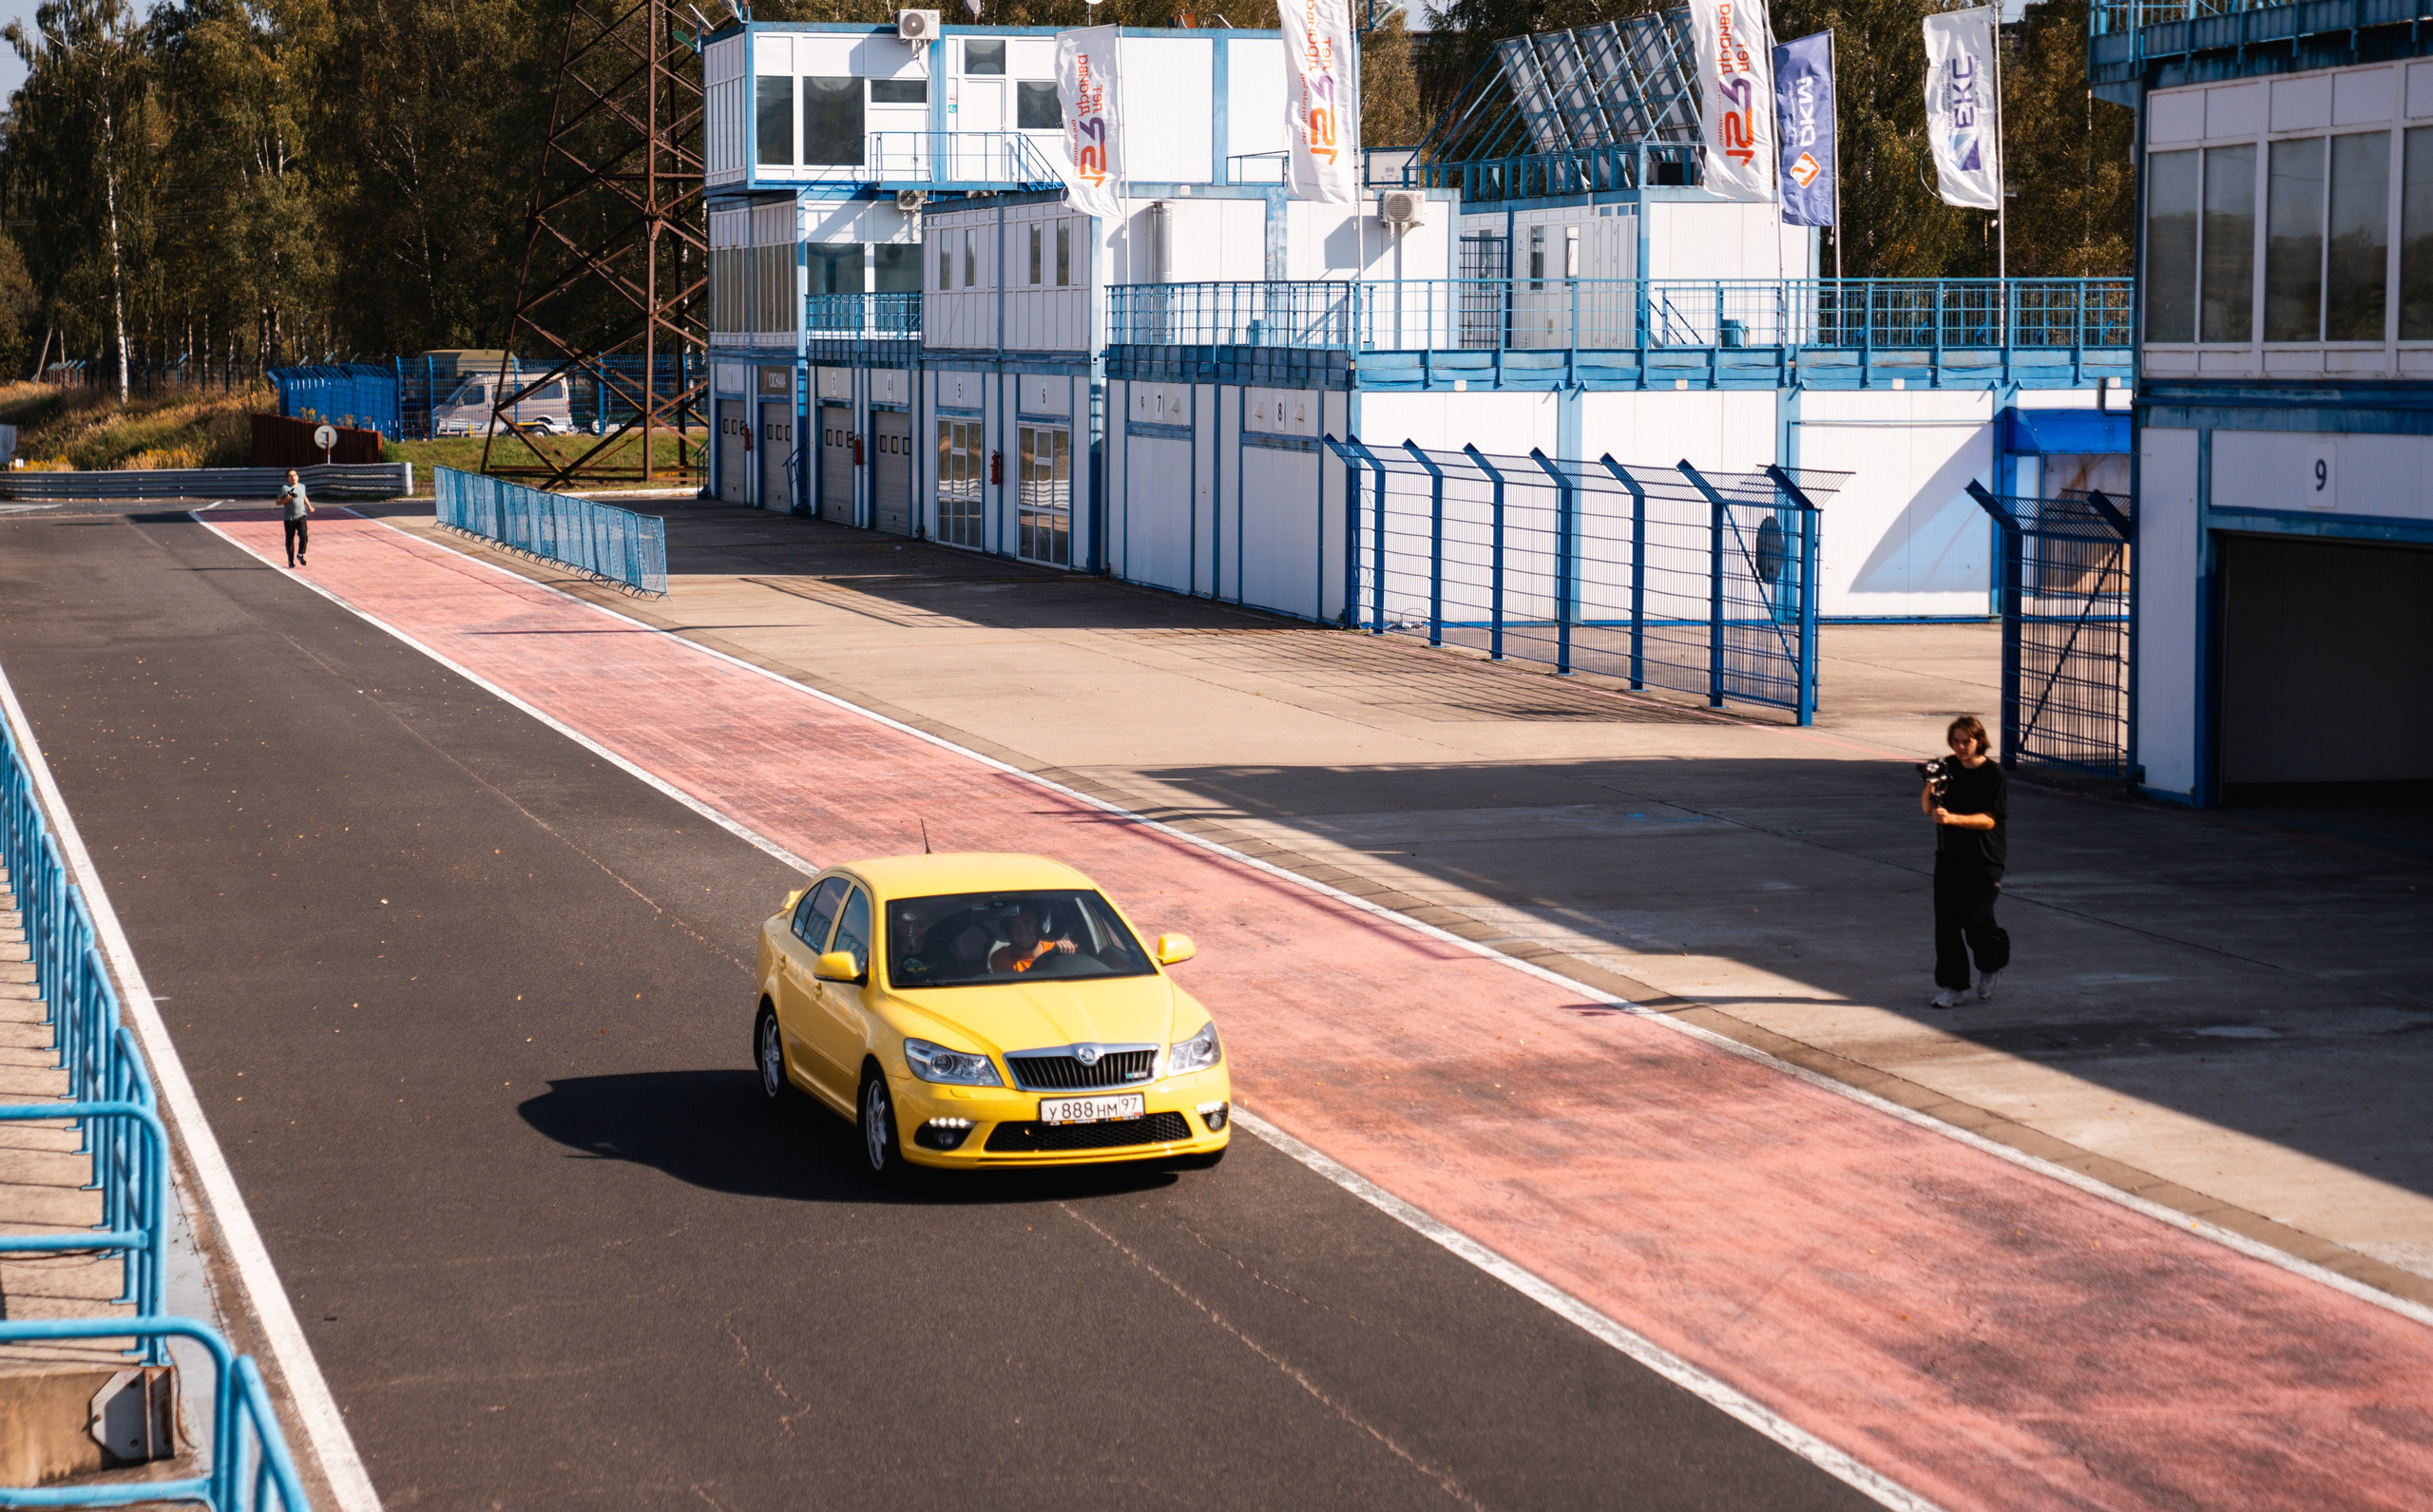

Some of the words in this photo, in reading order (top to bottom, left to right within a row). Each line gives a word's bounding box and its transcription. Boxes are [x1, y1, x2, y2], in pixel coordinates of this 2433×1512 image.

[1042, 388, 1045, 404] 6
[1157, 394, 1161, 412] 7
[1277, 402, 1283, 421] 8
[2315, 458, 2327, 491] 9
